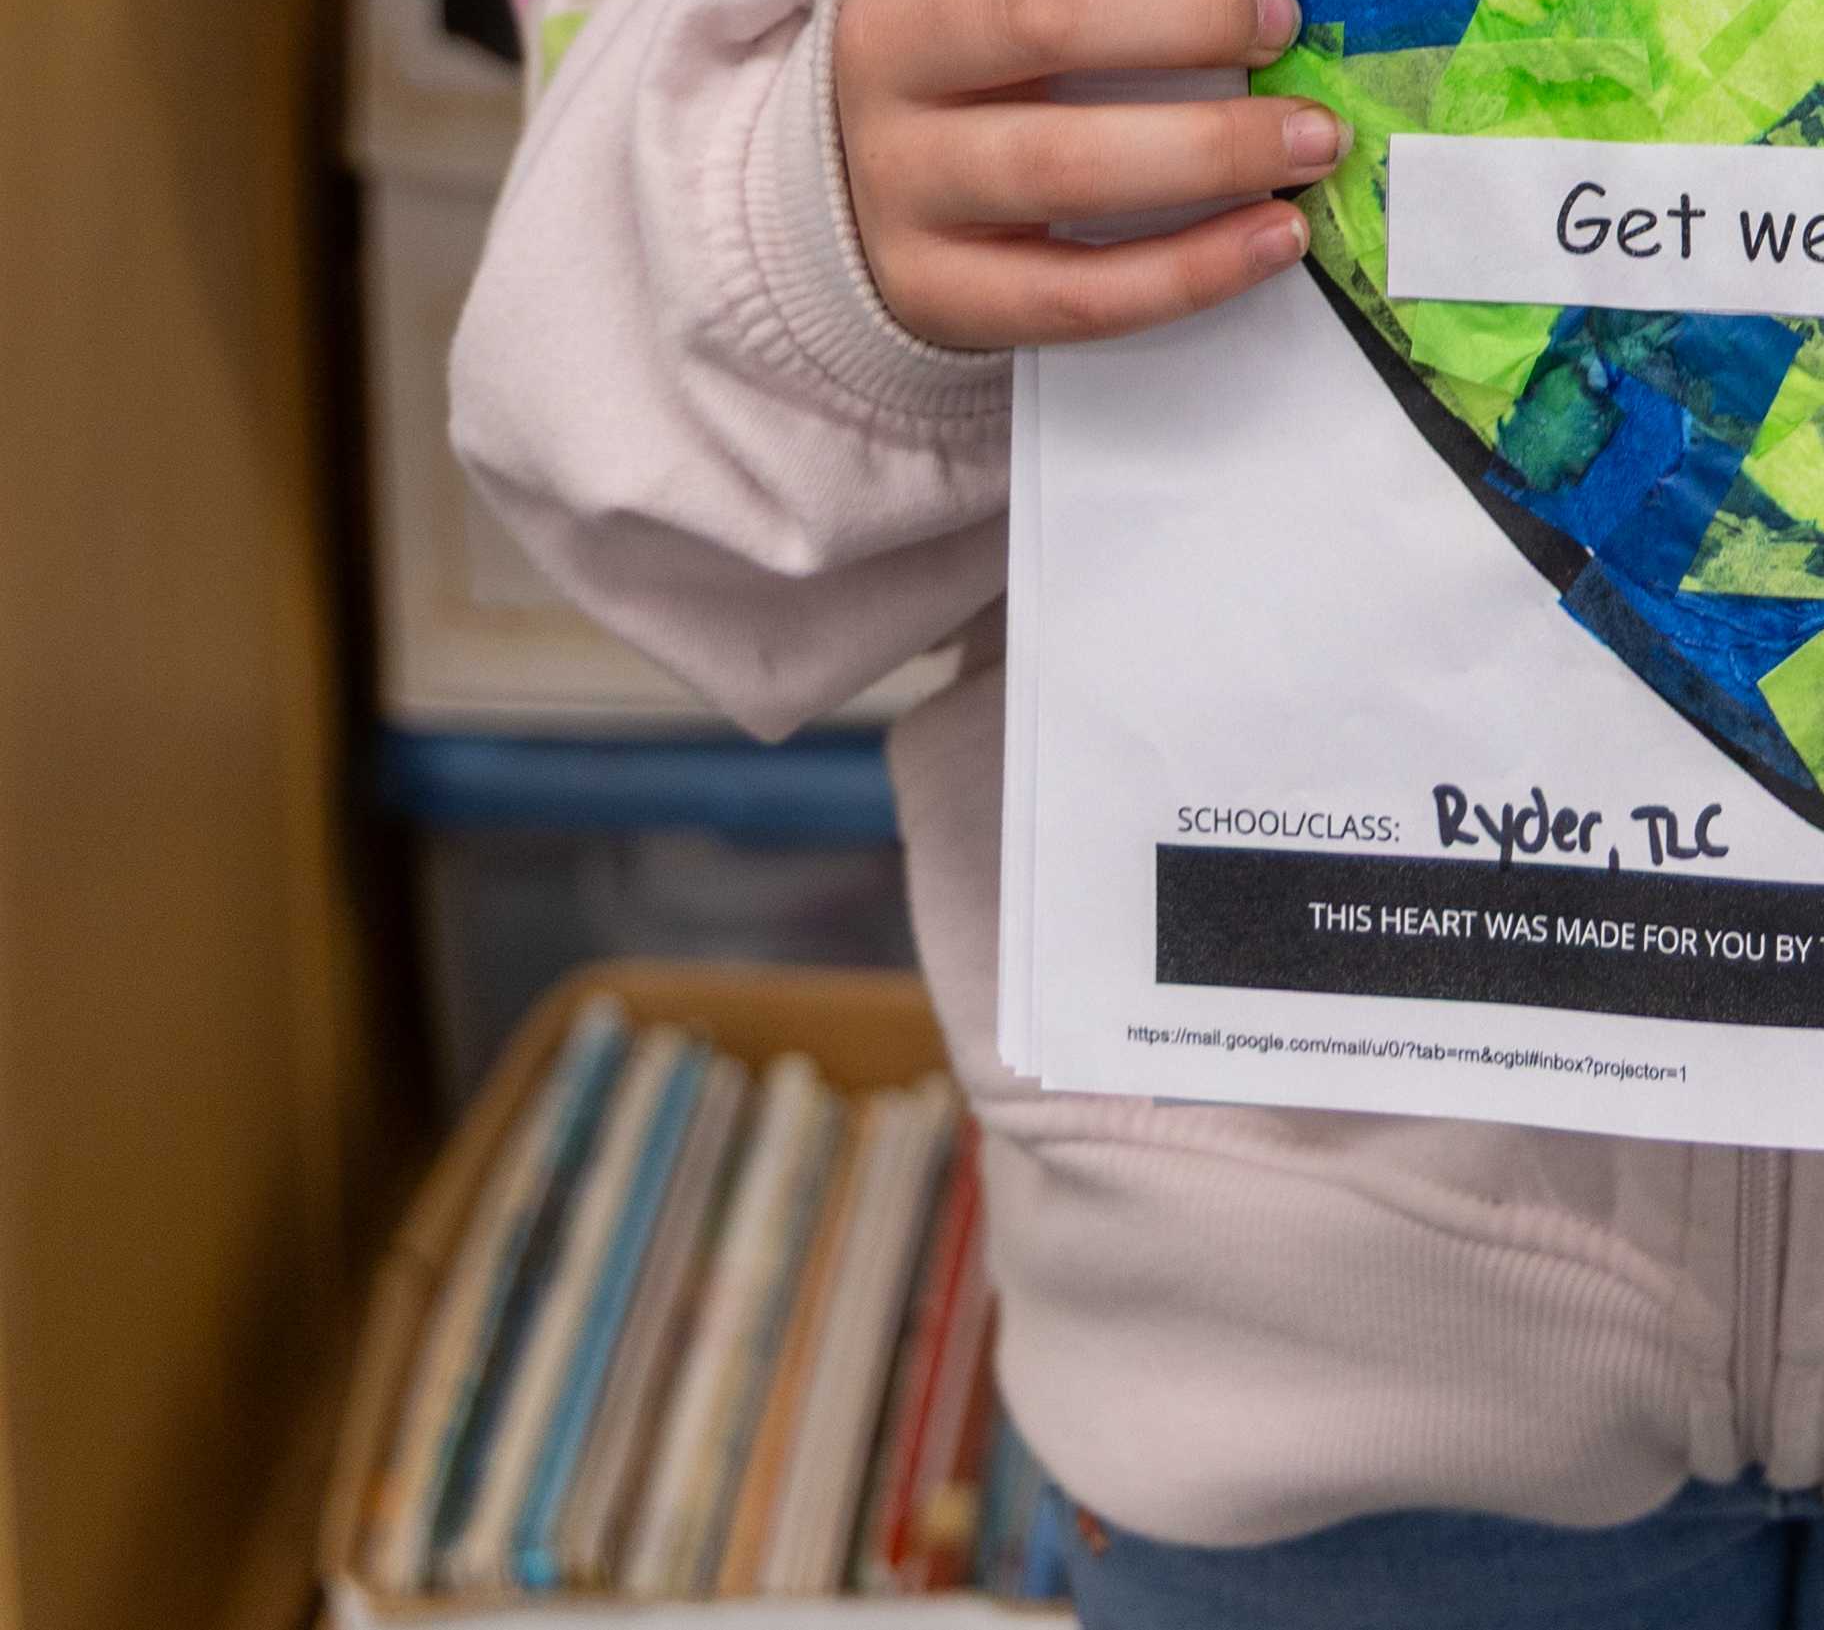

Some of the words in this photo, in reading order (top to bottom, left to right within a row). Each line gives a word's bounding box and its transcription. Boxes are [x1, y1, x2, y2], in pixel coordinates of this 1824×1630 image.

[1556, 180, 1707, 260] Get
[1177, 806, 1400, 843] SCHOOL/CLASS:
[1432, 784, 1619, 874] Ryder,
[1631, 803, 1729, 866] TLC
[1307, 901, 1373, 933] THIS
[1380, 905, 1478, 939] HEART
[1483, 910, 1548, 944] WAS
[1555, 916, 1636, 951] MADE
[1642, 923, 1698, 957] FOR
[1704, 928, 1766, 962] YOU
[1775, 934, 1813, 964] BY
